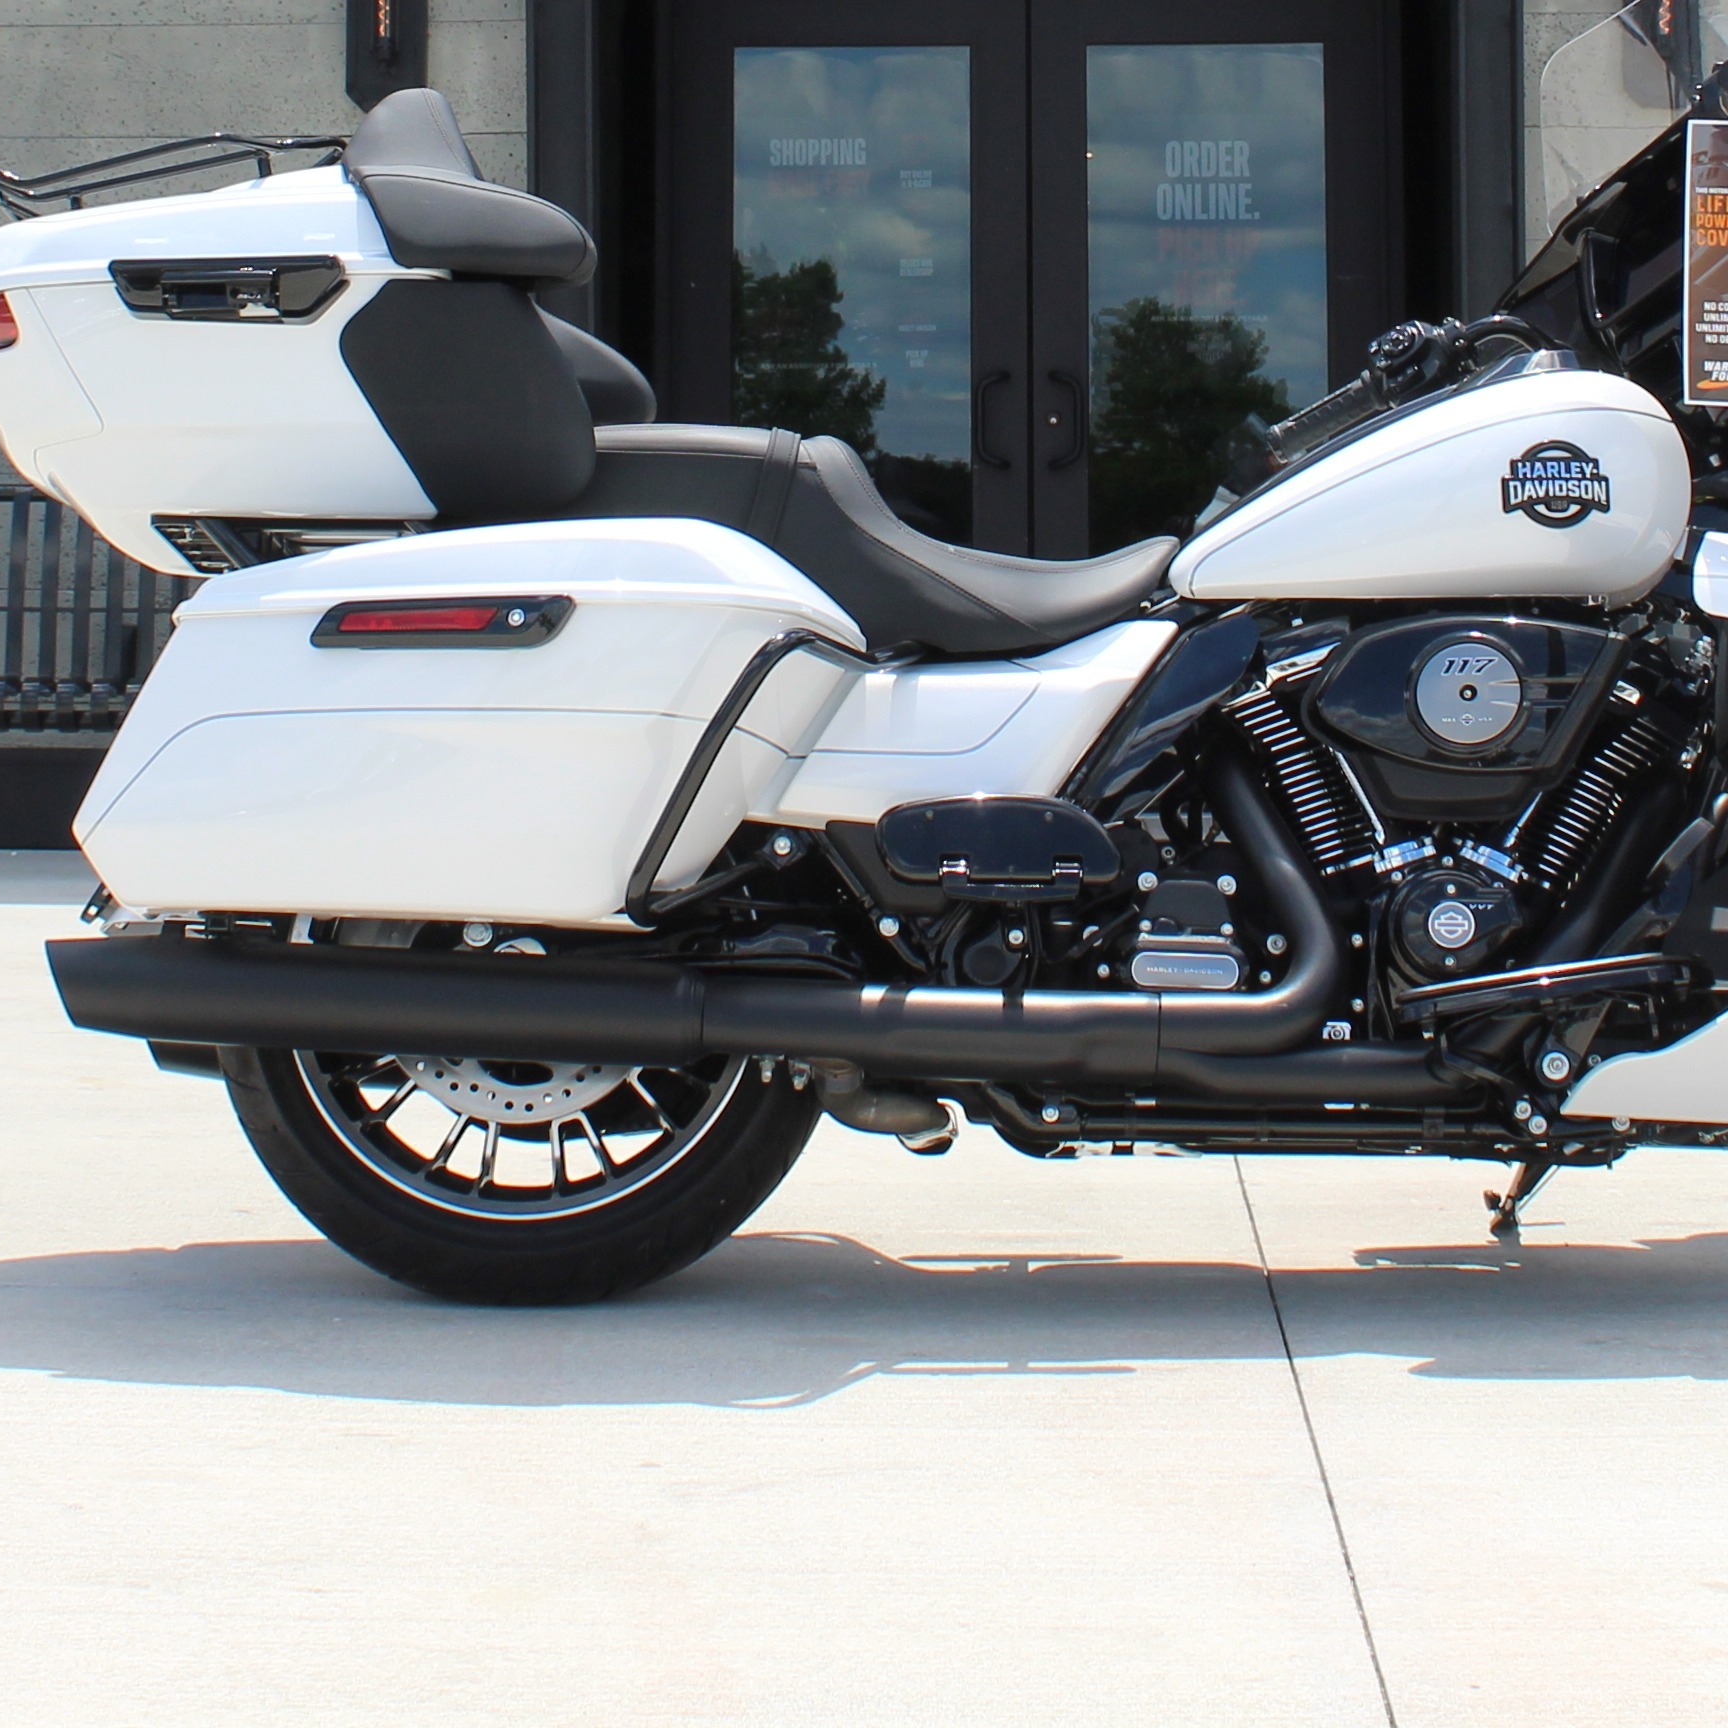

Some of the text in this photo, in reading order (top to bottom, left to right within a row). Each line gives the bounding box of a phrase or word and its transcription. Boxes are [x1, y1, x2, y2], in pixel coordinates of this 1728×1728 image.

[769, 137, 867, 166] SHOPPING
[1165, 140, 1250, 178] ORDER
[1156, 183, 1261, 221] ONLINE.
[1703, 301, 1717, 311] NO
[1704, 334, 1718, 344] NO
[1517, 461, 1598, 478] HARLEY-
[1508, 478, 1608, 506] DAVIDSON
[1441, 656, 1499, 676] 117
